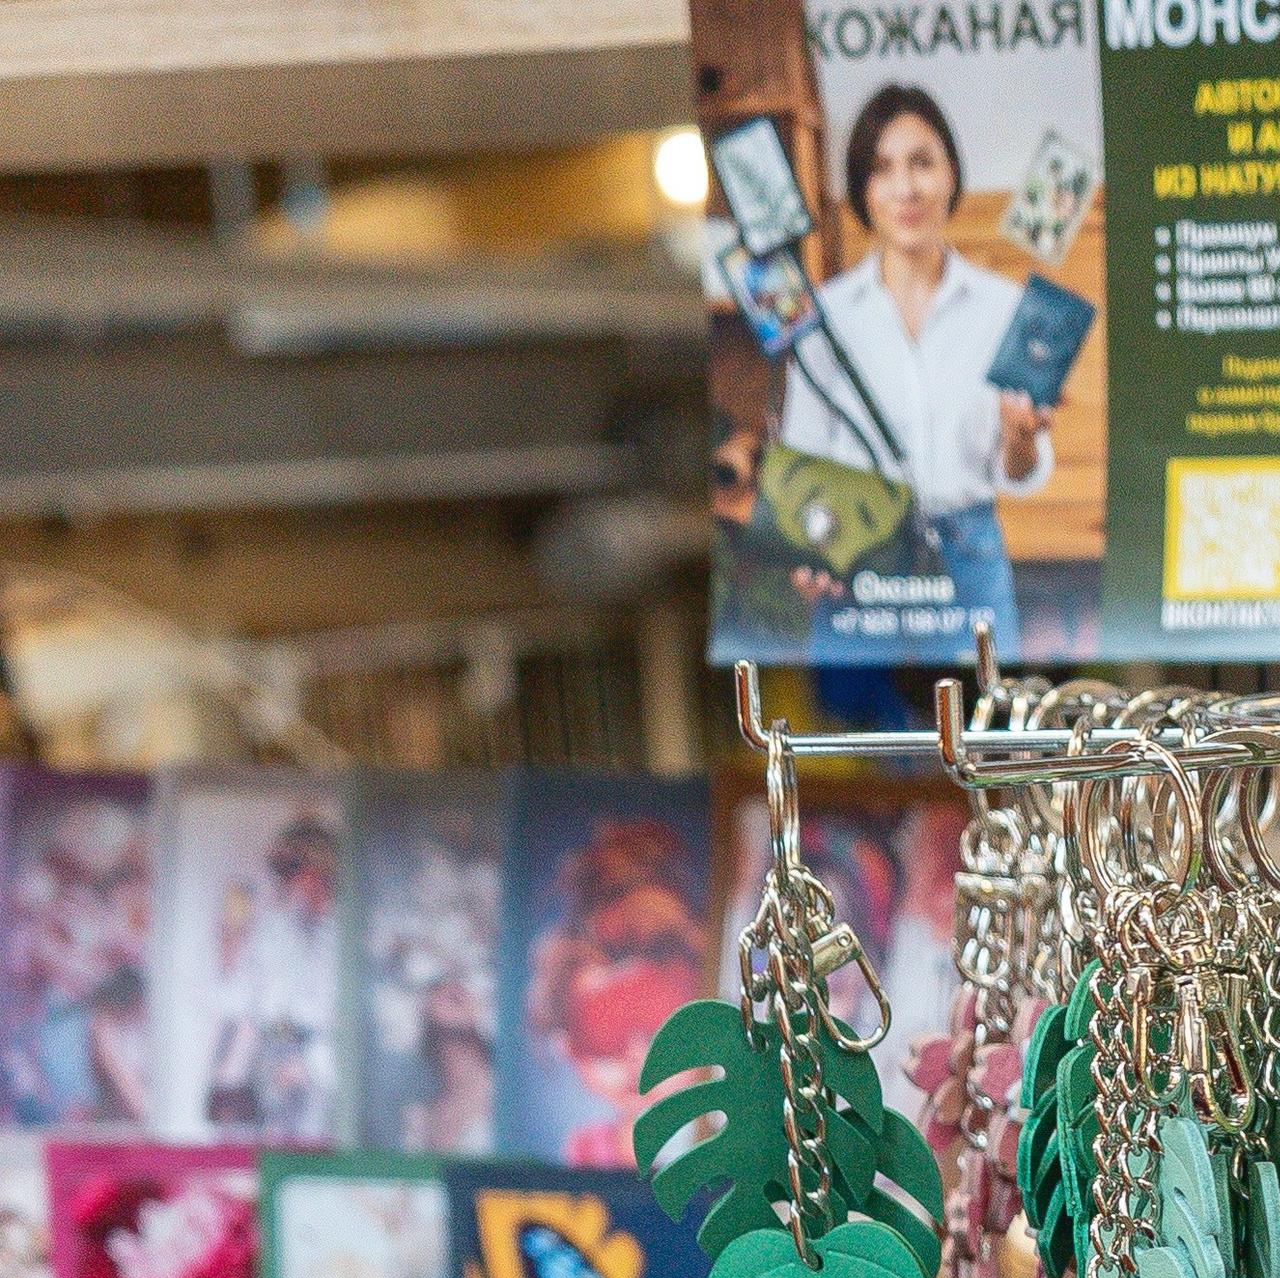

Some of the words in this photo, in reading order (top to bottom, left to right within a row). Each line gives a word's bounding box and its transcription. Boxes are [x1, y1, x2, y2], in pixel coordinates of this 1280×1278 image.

[805, 2, 1084, 59] КОЖАНАЯ
[1228, 121, 1253, 154] И
[1154, 164, 1196, 200] ИЗ
